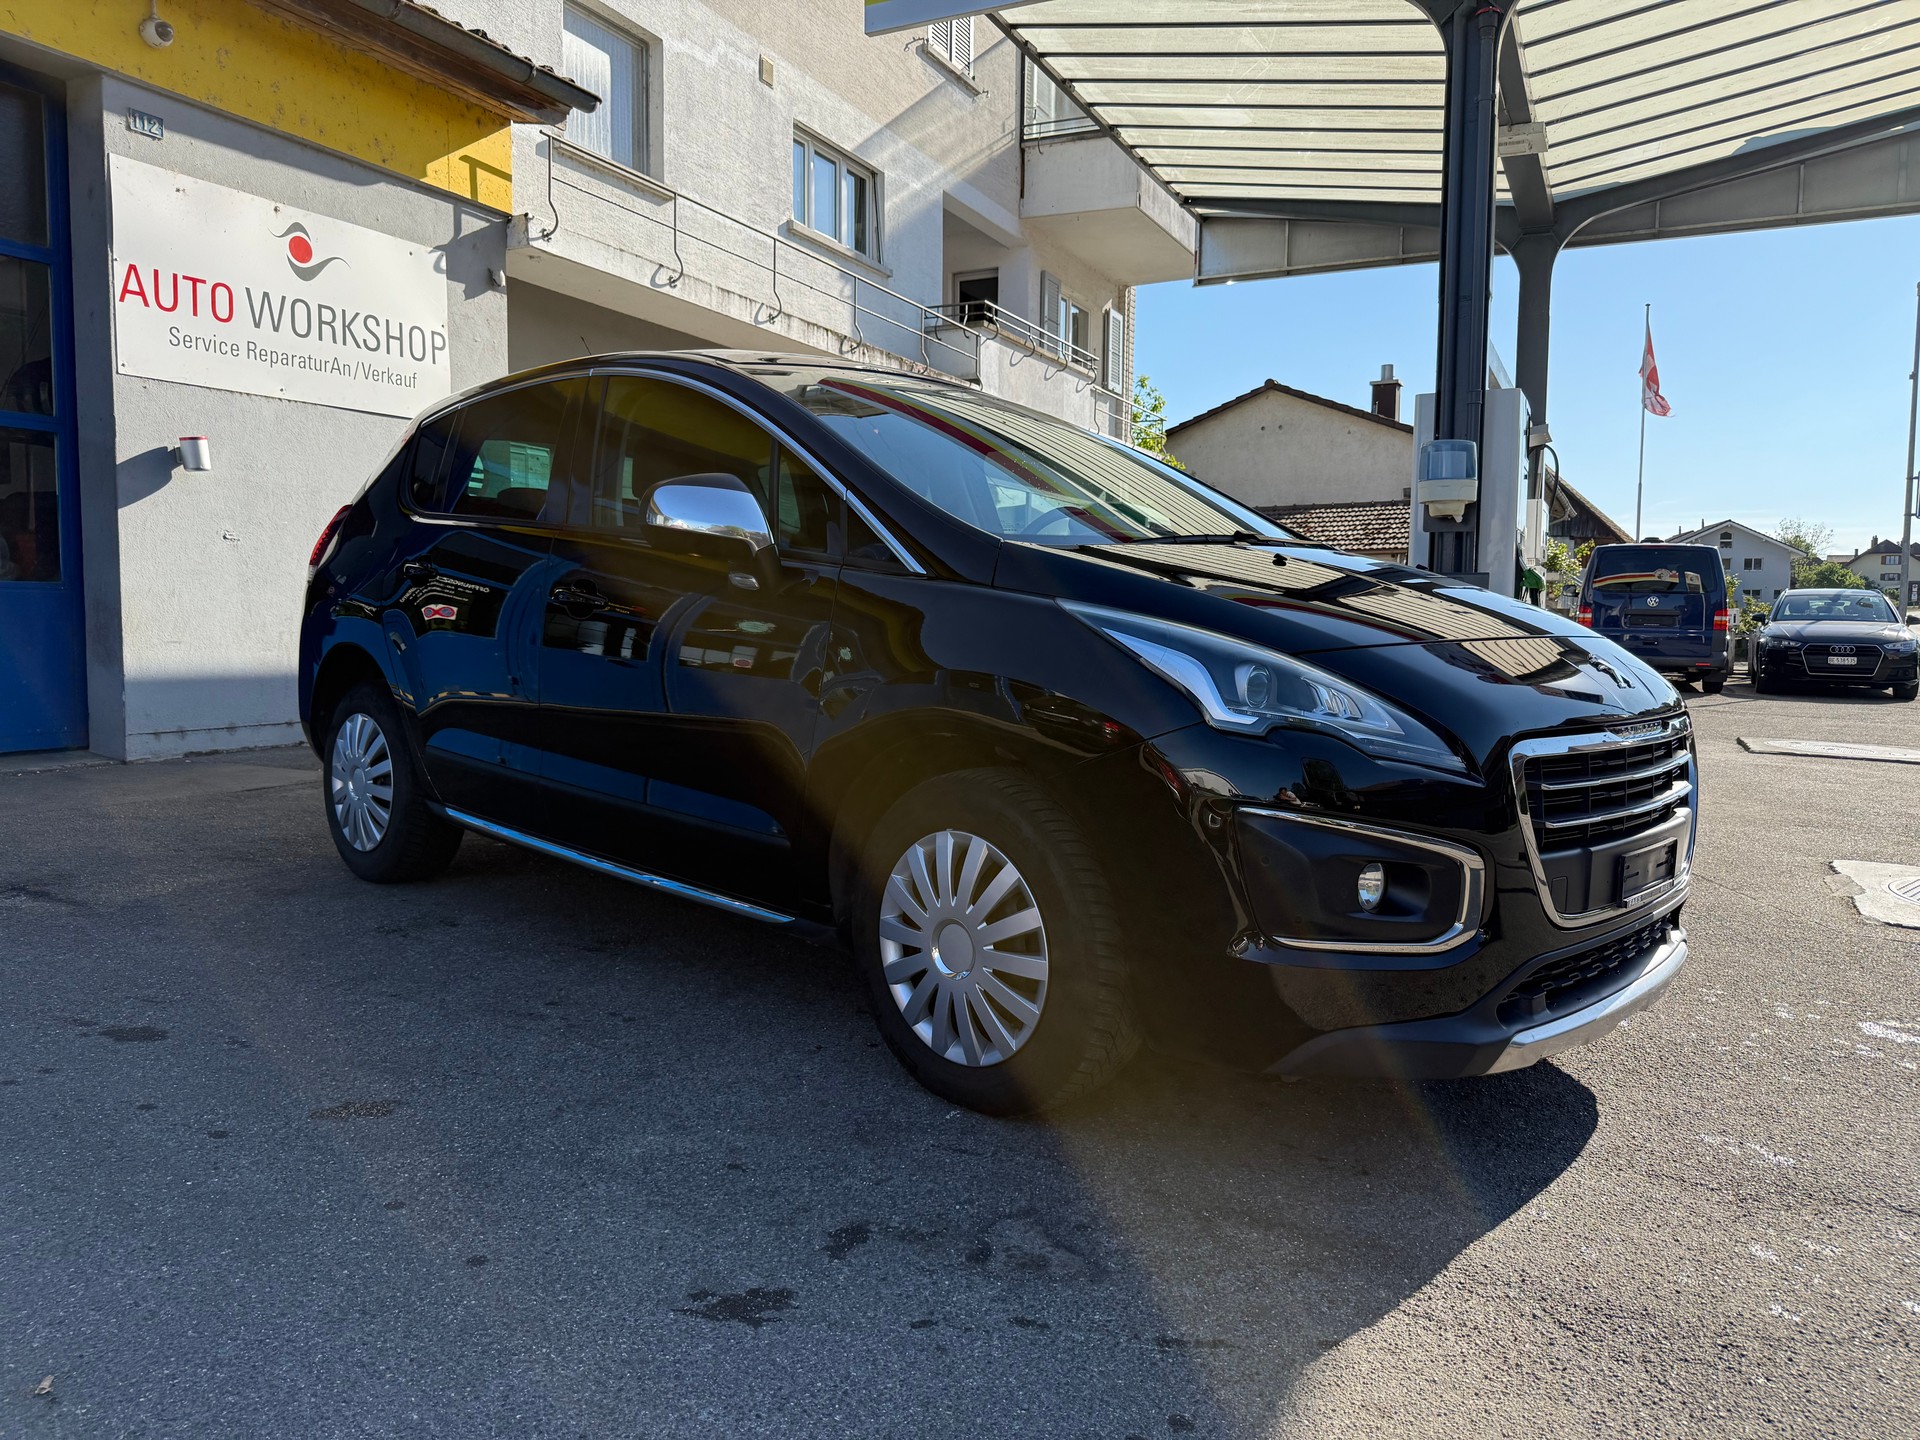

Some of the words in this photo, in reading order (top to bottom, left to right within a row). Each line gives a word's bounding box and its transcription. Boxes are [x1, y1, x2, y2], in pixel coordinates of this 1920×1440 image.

[134, 112, 159, 135] 112
[118, 263, 234, 323] AUTO
[245, 286, 447, 365] WORKSHOP
[169, 326, 240, 358] Service
